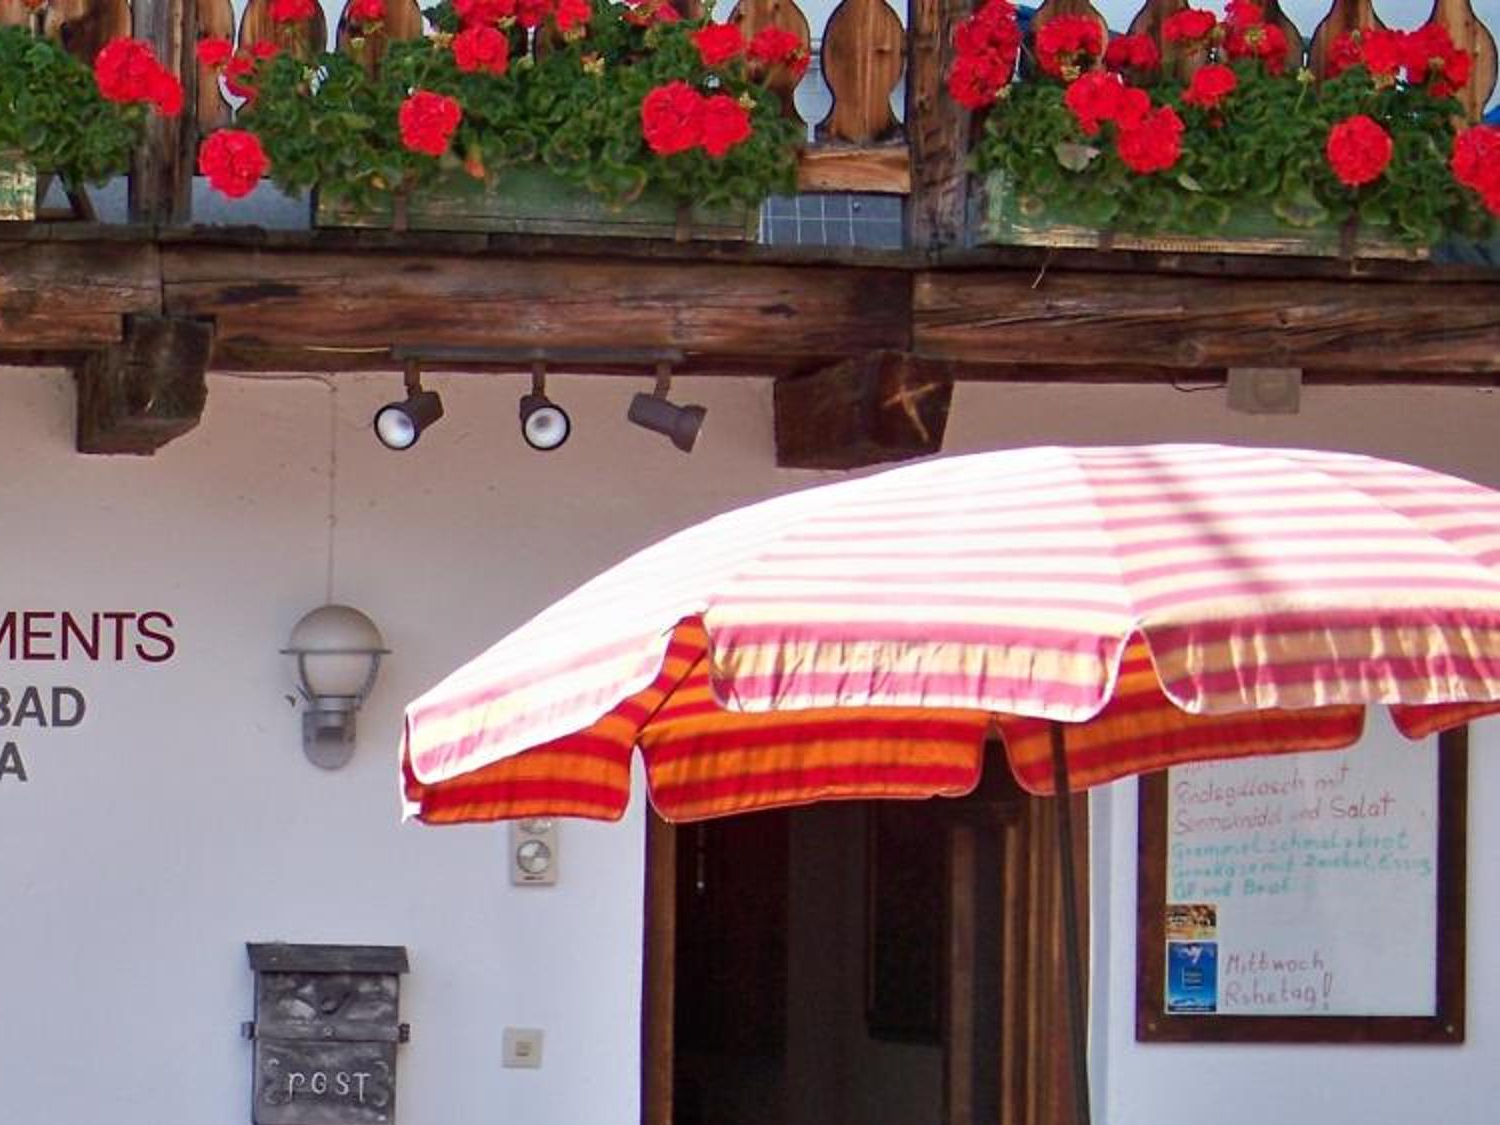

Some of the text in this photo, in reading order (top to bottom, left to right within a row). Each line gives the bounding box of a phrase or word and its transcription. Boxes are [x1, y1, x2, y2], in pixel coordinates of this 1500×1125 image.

[1330, 790, 1397, 819] Salat
[1225, 951, 1325, 976] Mittwoch
[287, 1071, 372, 1103] POST
